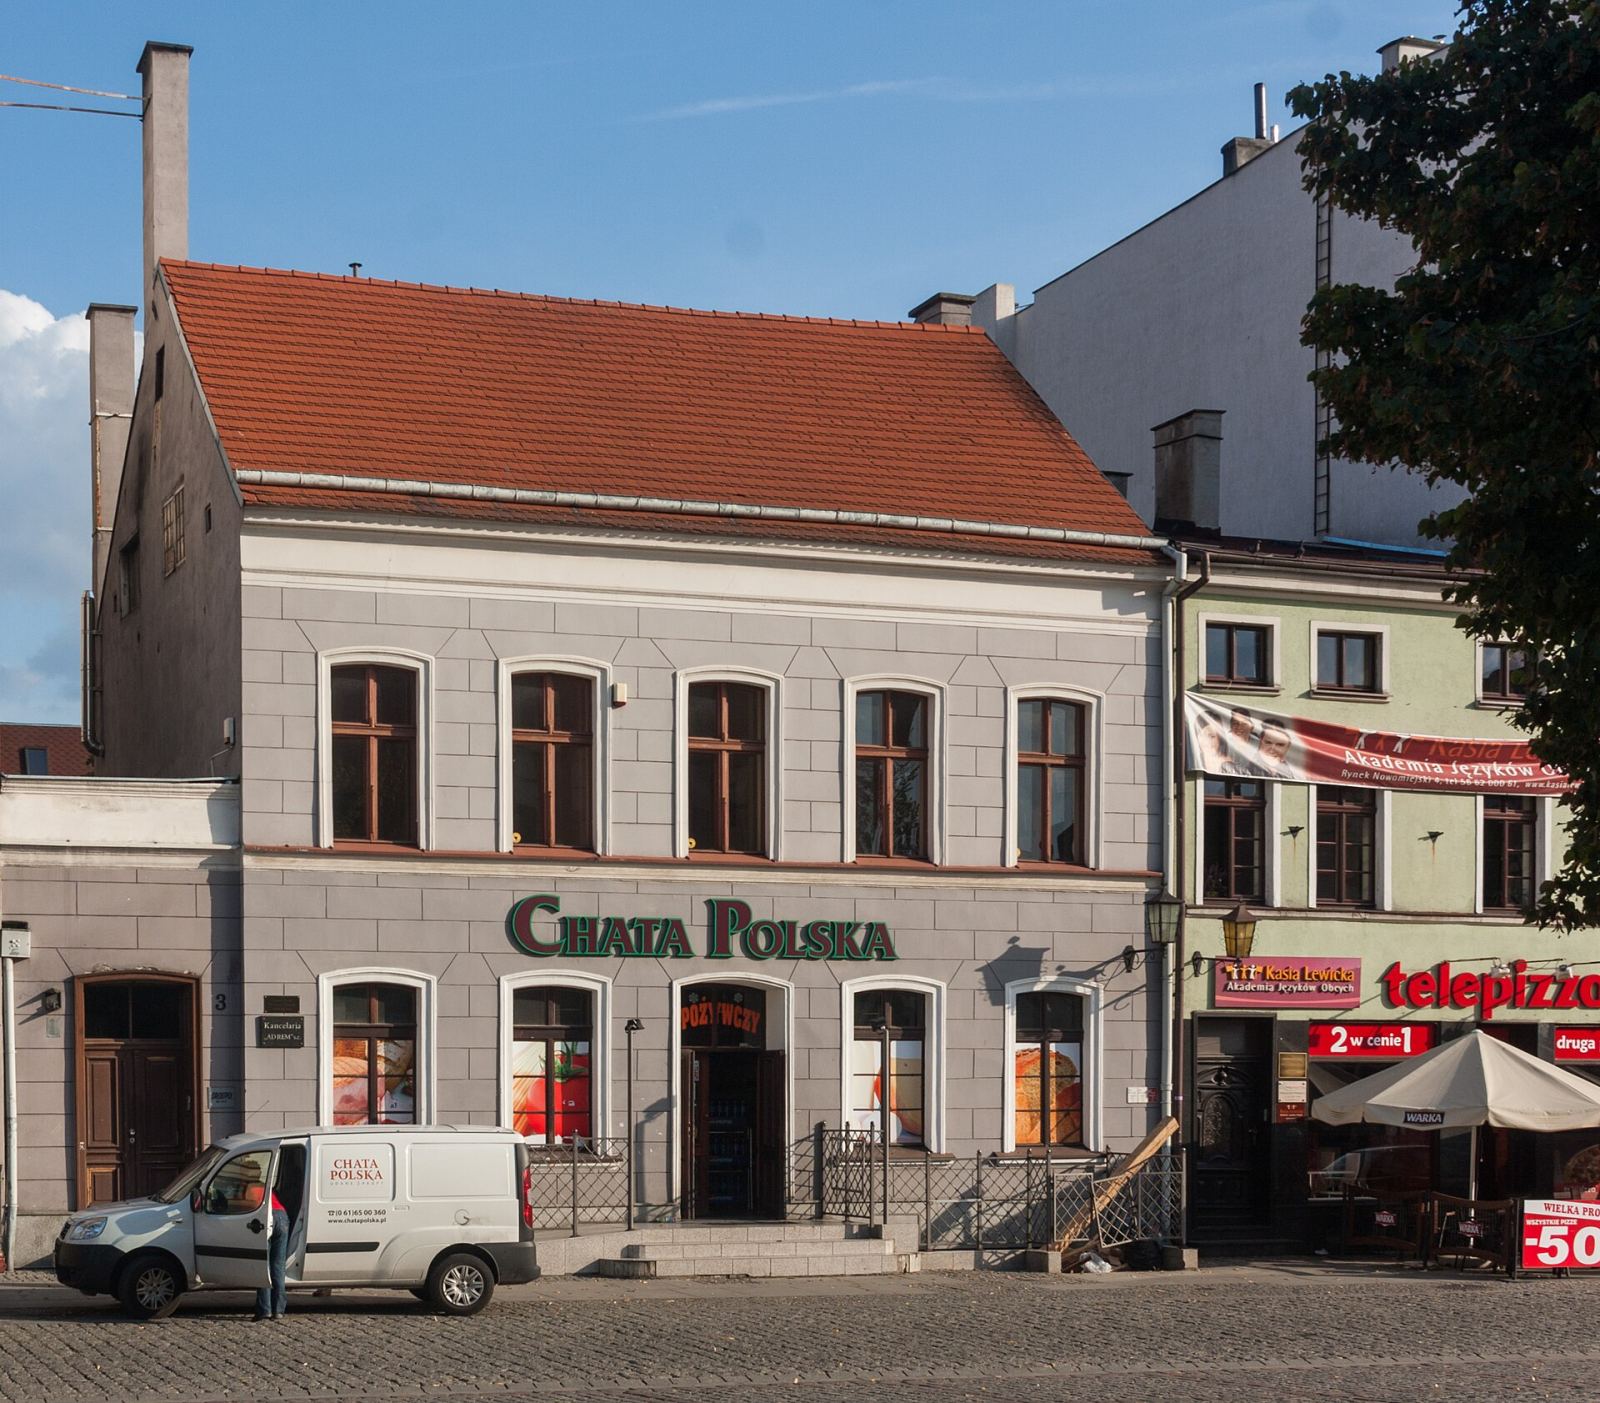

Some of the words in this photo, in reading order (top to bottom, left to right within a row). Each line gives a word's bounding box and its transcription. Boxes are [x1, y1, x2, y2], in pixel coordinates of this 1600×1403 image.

[1344, 749, 1444, 775] Akademia
[1452, 760, 1534, 779] Języków
[1341, 769, 1370, 780] Rynek
[1372, 772, 1432, 785] Nowomiejski
[1266, 965, 1301, 981] Kasia
[1304, 965, 1355, 981] Lewicka
[1226, 982, 1275, 992] Akademia
[1278, 982, 1317, 994] Języków
[1321, 983, 1354, 993] Obcych
[216, 994, 226, 1011] 3
[264, 1021, 302, 1030] Kancelaria
[1330, 1026, 1348, 1053] 2
[1350, 1037, 1363, 1047] w
[1367, 1033, 1402, 1047] cenie
[1401, 1026, 1412, 1053] 1
[1556, 1034, 1596, 1053] druga
[1406, 1113, 1442, 1123] WARKA
[333, 1159, 379, 1169] CHATA
[330, 1170, 384, 1181] POLSKA
[1544, 1203, 1580, 1215] WIELKA
